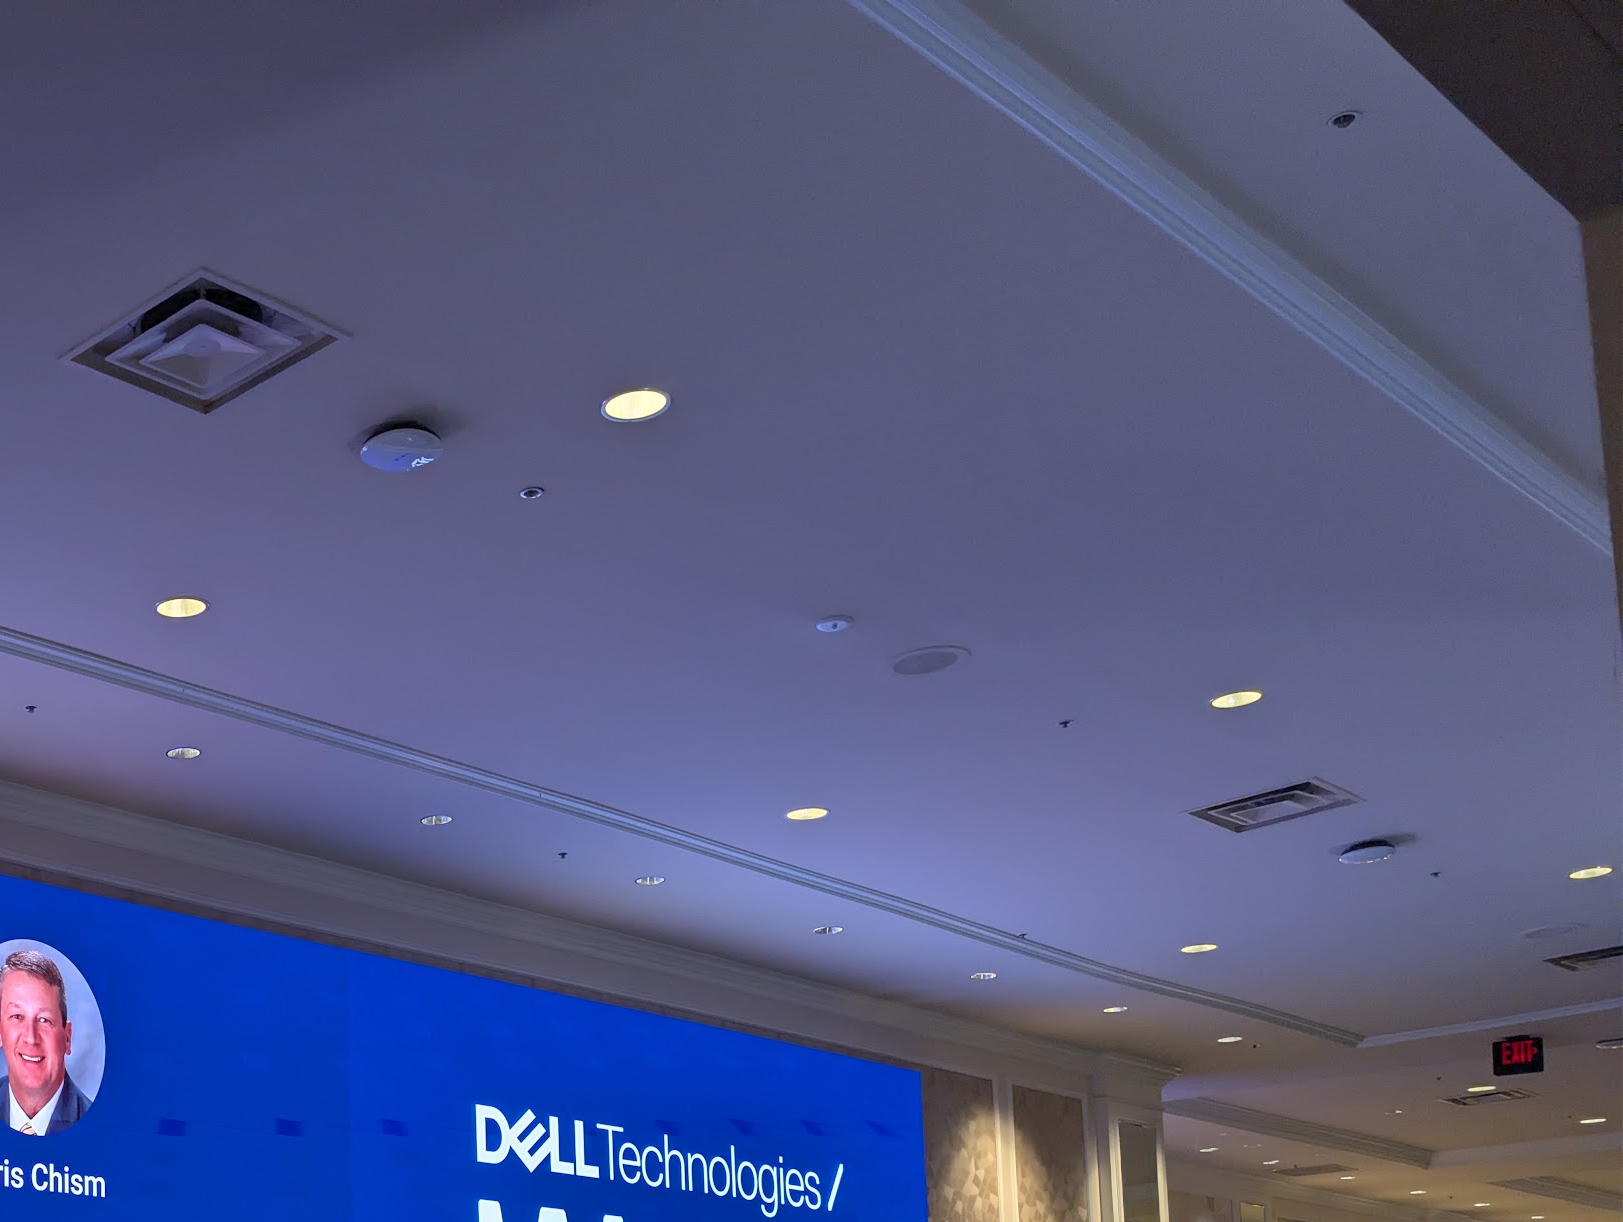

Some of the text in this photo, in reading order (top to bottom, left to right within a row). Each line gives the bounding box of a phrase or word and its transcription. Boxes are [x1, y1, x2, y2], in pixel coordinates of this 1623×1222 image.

[1501, 1040, 1534, 1065] EXIT
[474, 1103, 600, 1179] DELL
[595, 1122, 823, 1218] Technologies
[30, 1161, 107, 1199] Chism
